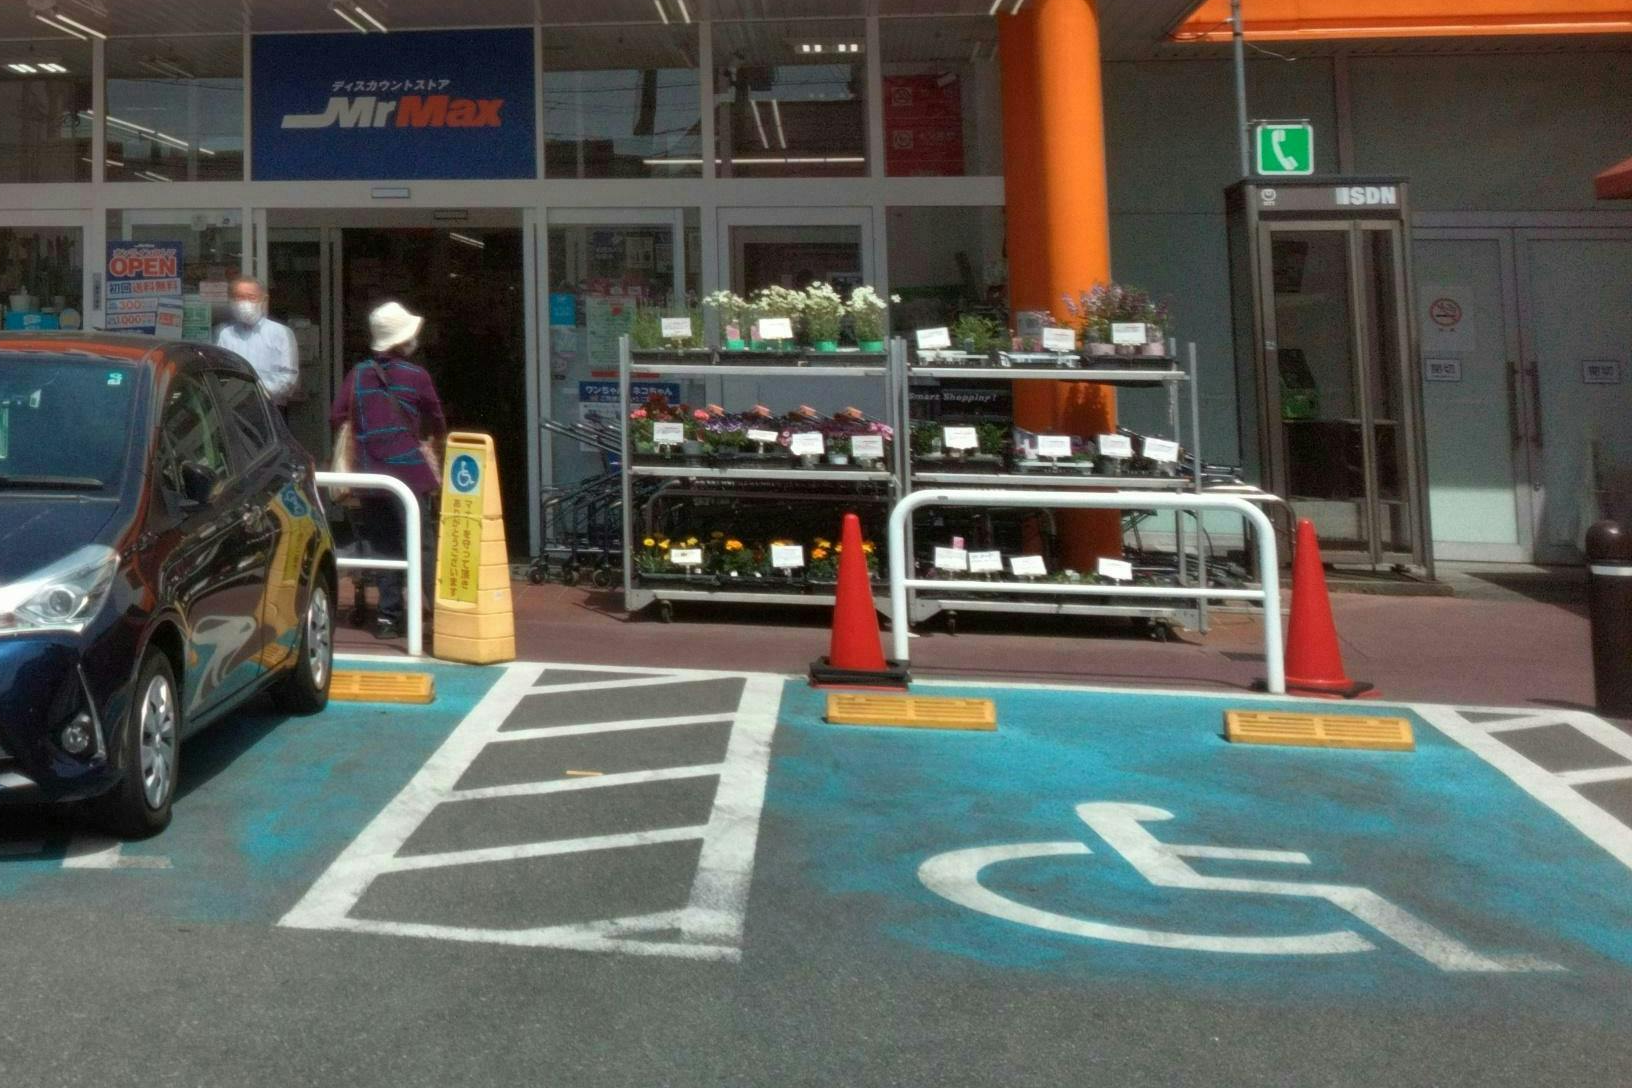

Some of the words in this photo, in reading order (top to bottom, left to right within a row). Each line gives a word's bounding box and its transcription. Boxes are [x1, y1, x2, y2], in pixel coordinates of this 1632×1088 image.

[331, 79, 451, 92] ディスカウントストア
[280, 95, 505, 129] MrMax
[1335, 186, 1397, 206] ISDN
[110, 255, 177, 277] OPEN
[109, 280, 177, 296] 初回送料無料
